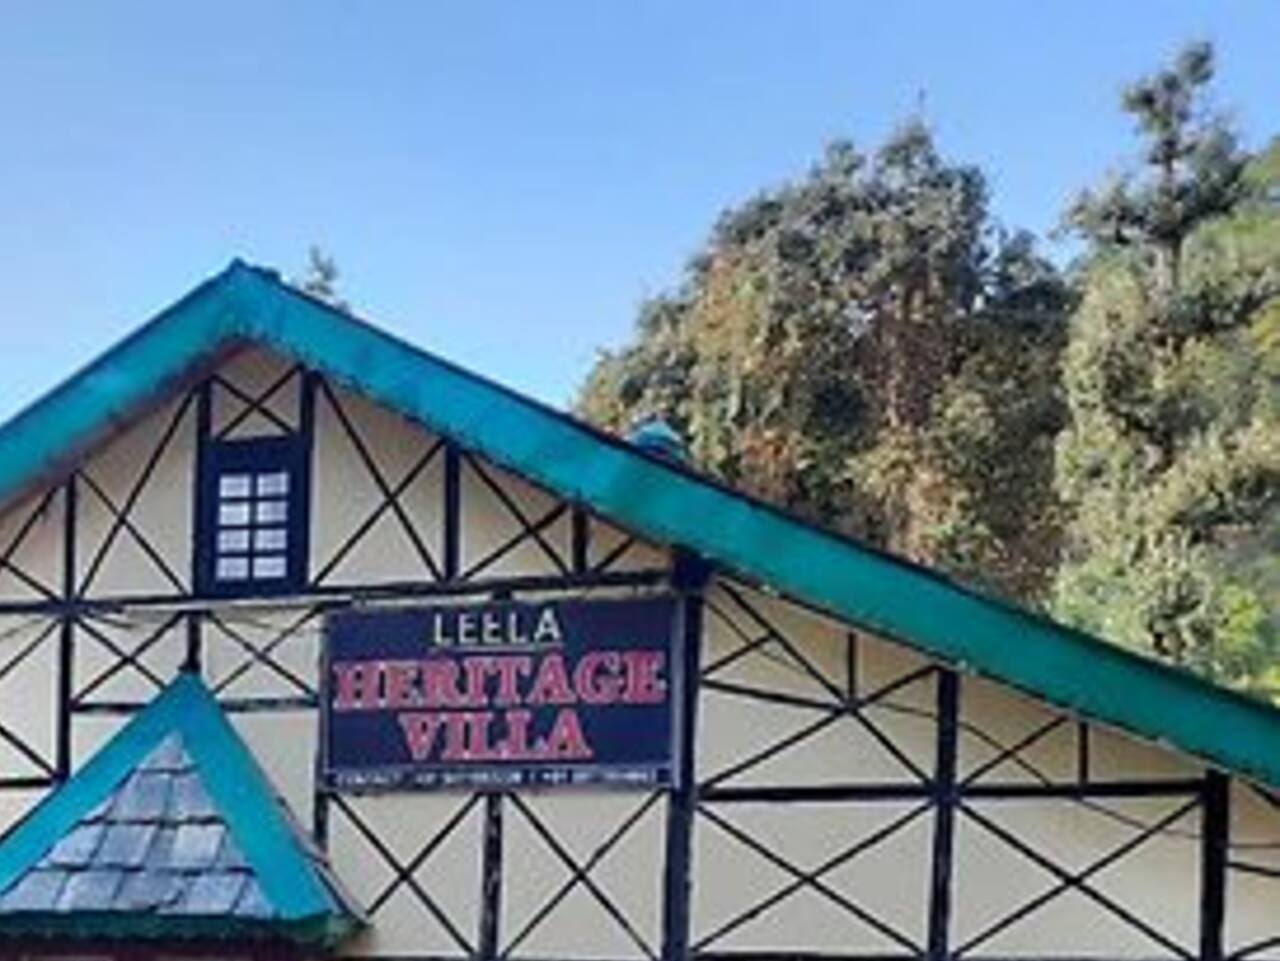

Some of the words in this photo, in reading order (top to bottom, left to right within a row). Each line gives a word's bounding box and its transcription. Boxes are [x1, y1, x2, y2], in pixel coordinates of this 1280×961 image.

[433, 608, 562, 645] LEELA
[332, 651, 667, 711] HERITAGE
[398, 709, 593, 761] VILLA
